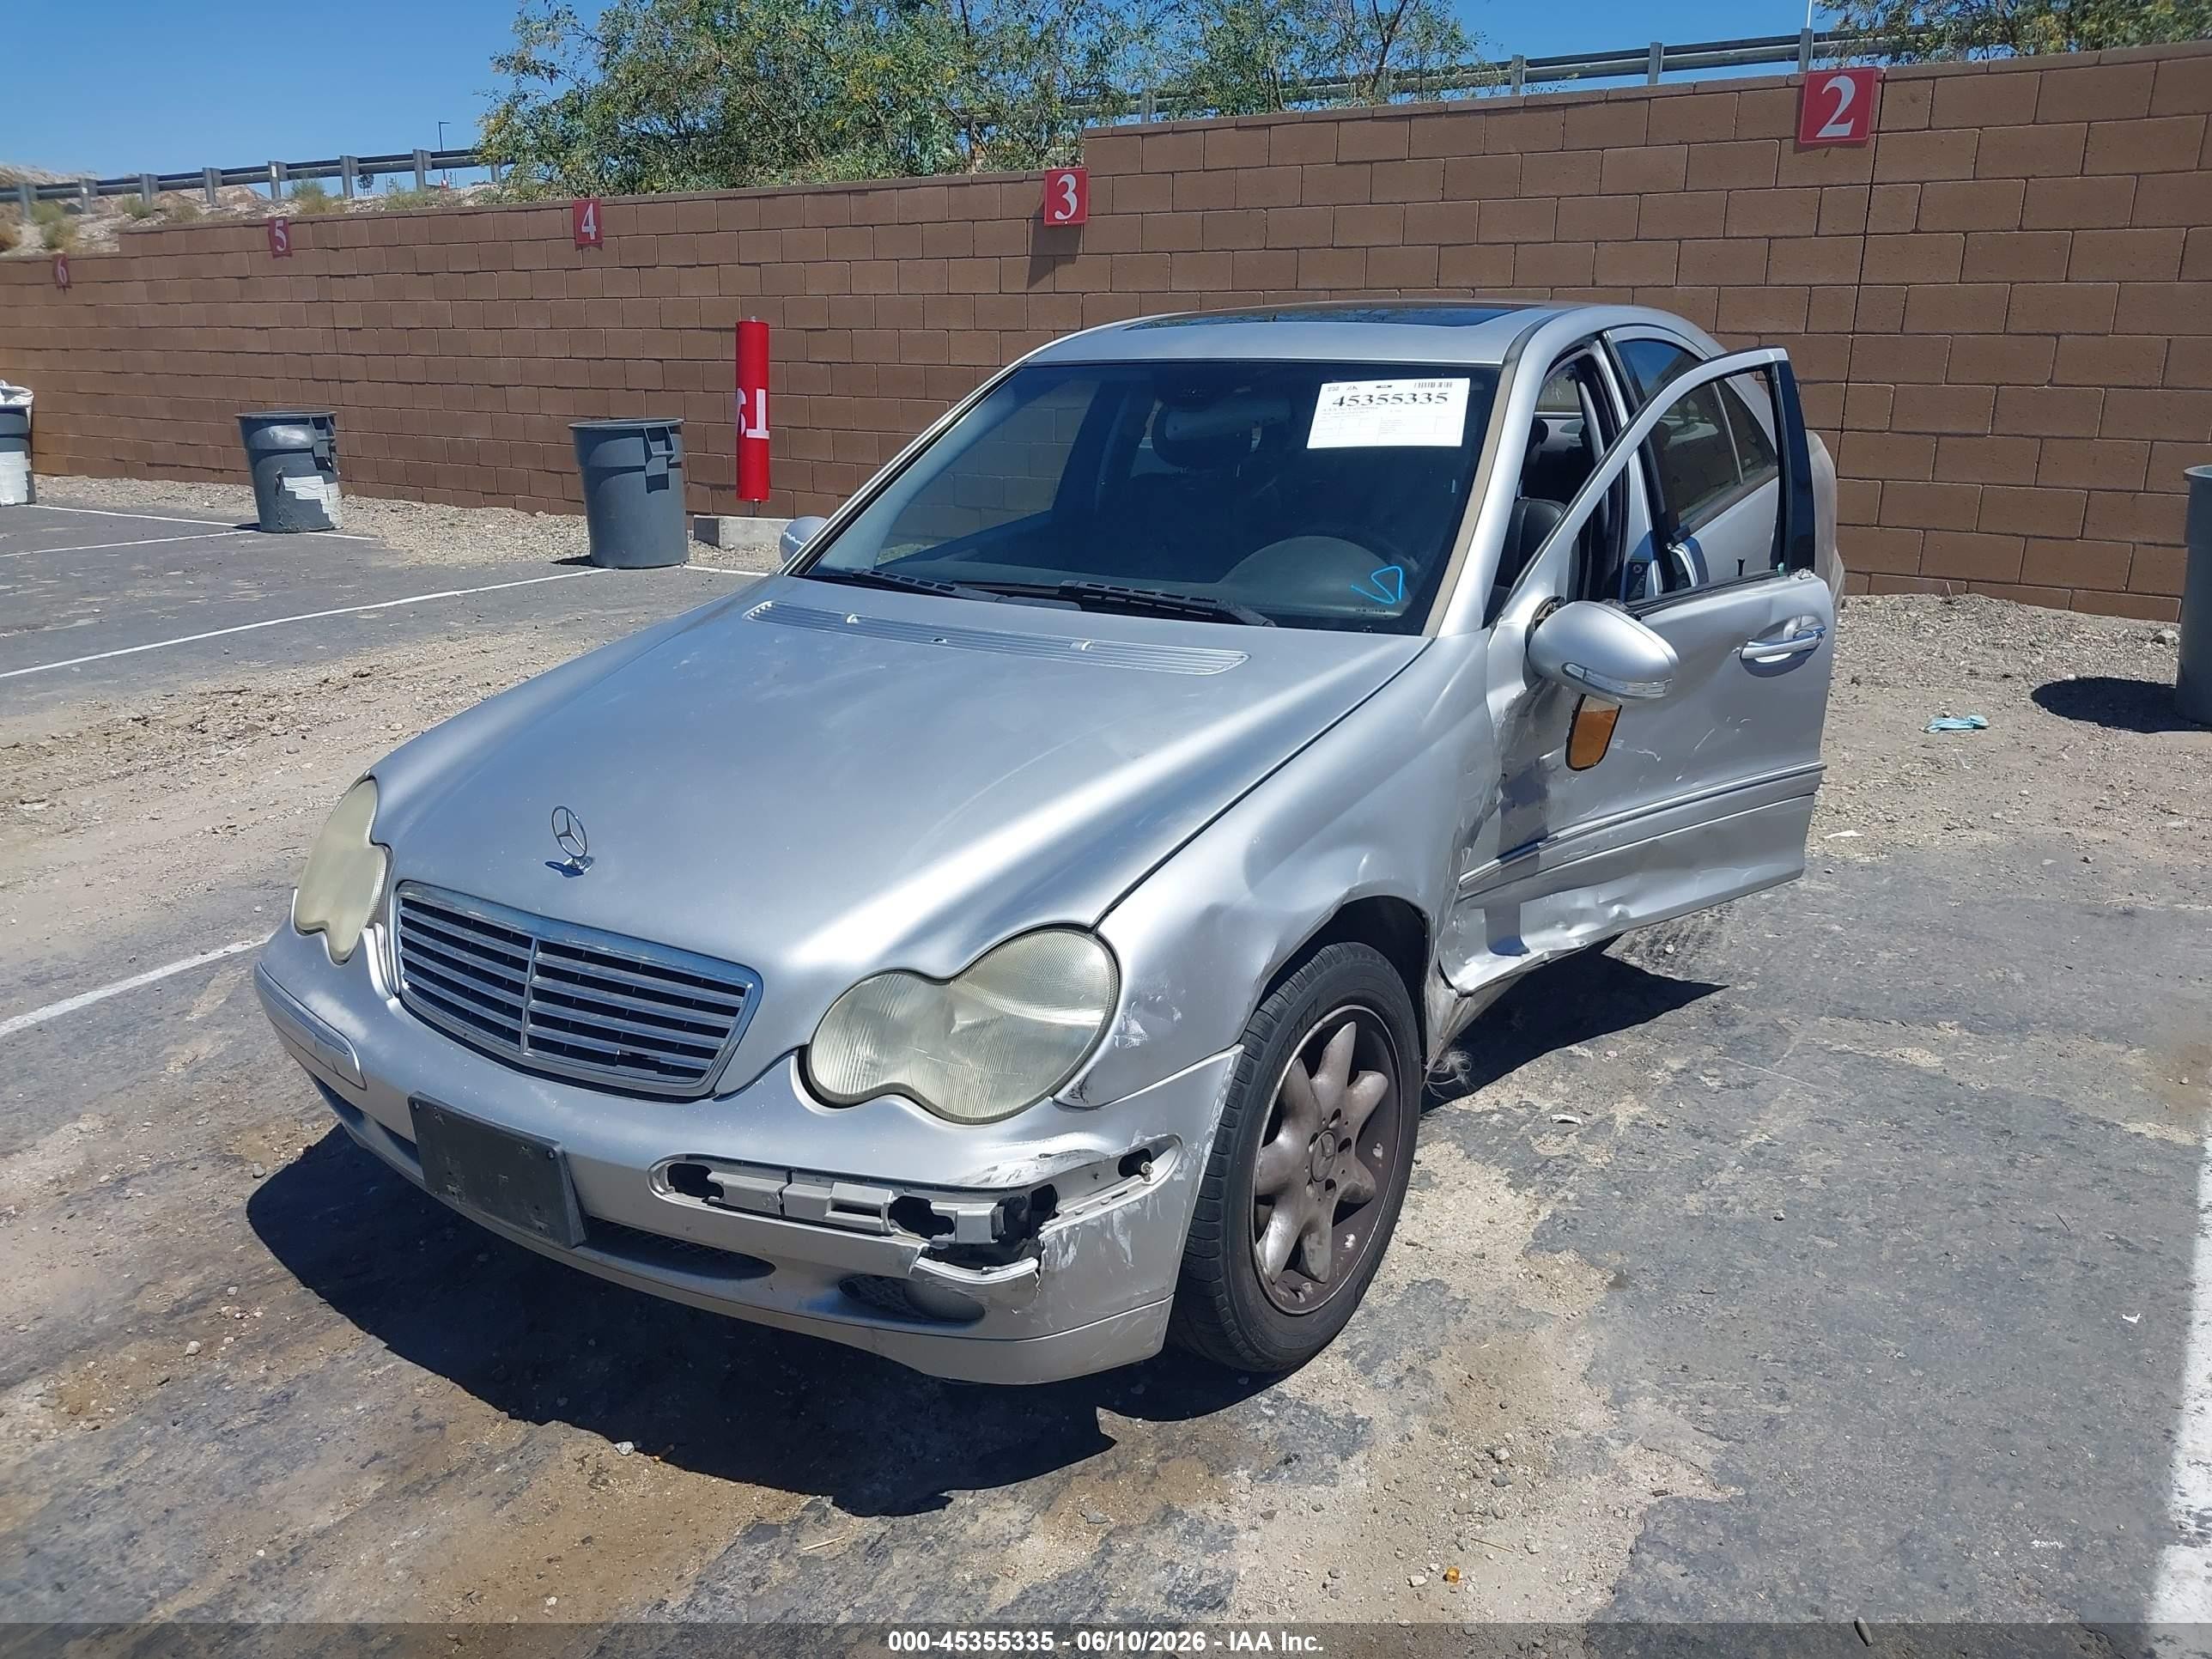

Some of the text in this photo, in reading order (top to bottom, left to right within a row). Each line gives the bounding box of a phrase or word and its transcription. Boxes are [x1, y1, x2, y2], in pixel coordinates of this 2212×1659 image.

[1815, 76, 1856, 138] 2
[1054, 173, 1078, 220] 3
[274, 220, 287, 252] 5
[581, 203, 597, 240] 4
[58, 258, 67, 283] 6
[1332, 392, 1448, 407] 45355335
